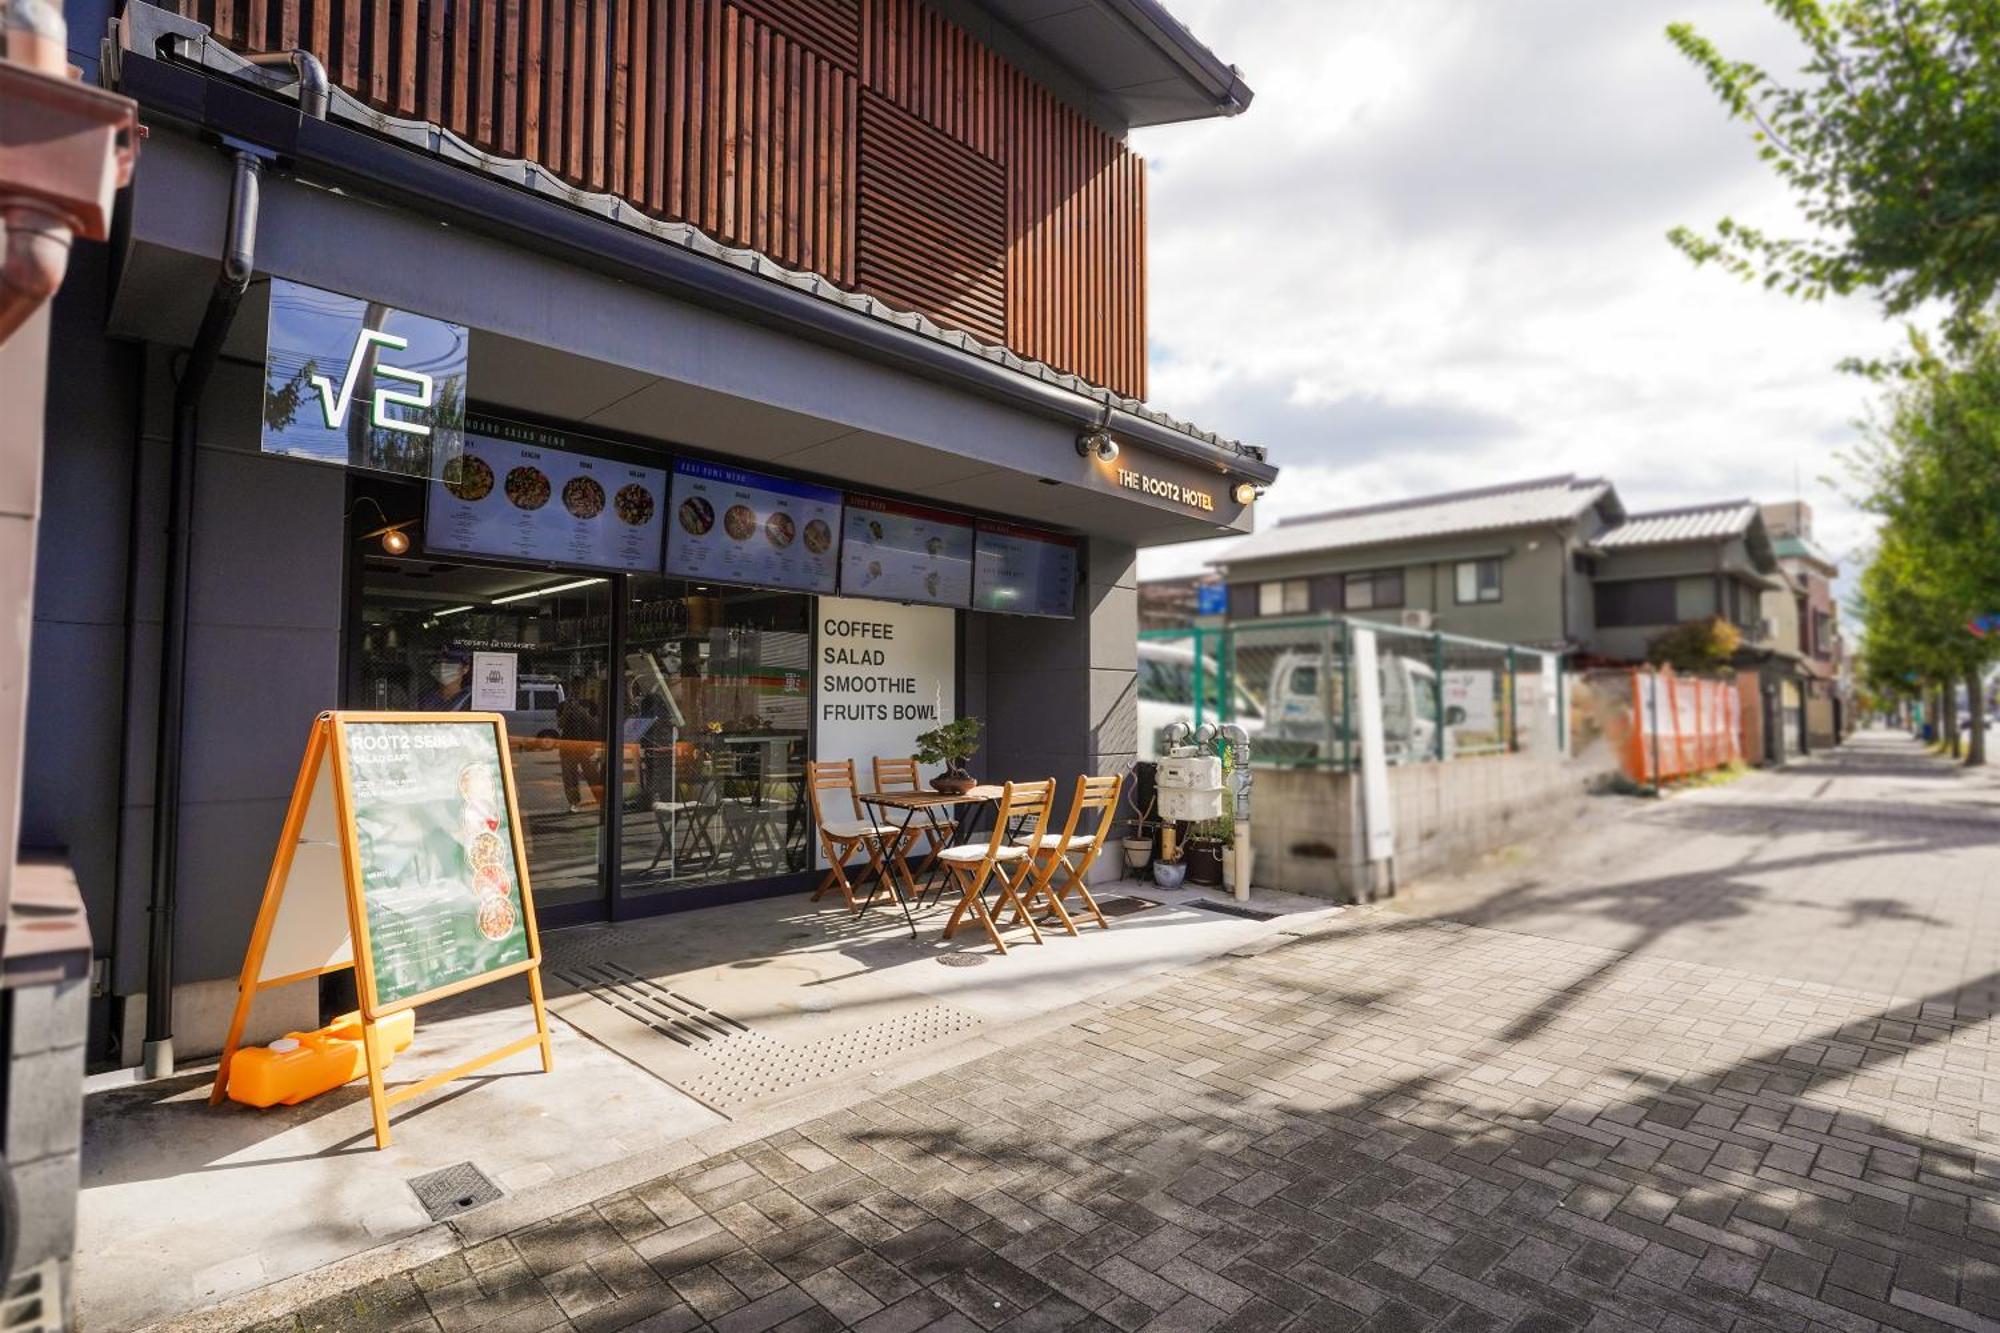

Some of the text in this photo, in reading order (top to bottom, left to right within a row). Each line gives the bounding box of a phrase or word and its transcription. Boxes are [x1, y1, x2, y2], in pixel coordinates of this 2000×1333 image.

[539, 434, 566, 447] MENU
[1118, 468, 1214, 511] THE ROOT2 HOTEL
[824, 619, 894, 640] COFFEE
[824, 647, 885, 666] SALAD
[824, 675, 917, 693] SMOOTHIE
[823, 704, 938, 720] FRUITS BOWL
[351, 735, 411, 751] ROOT2
